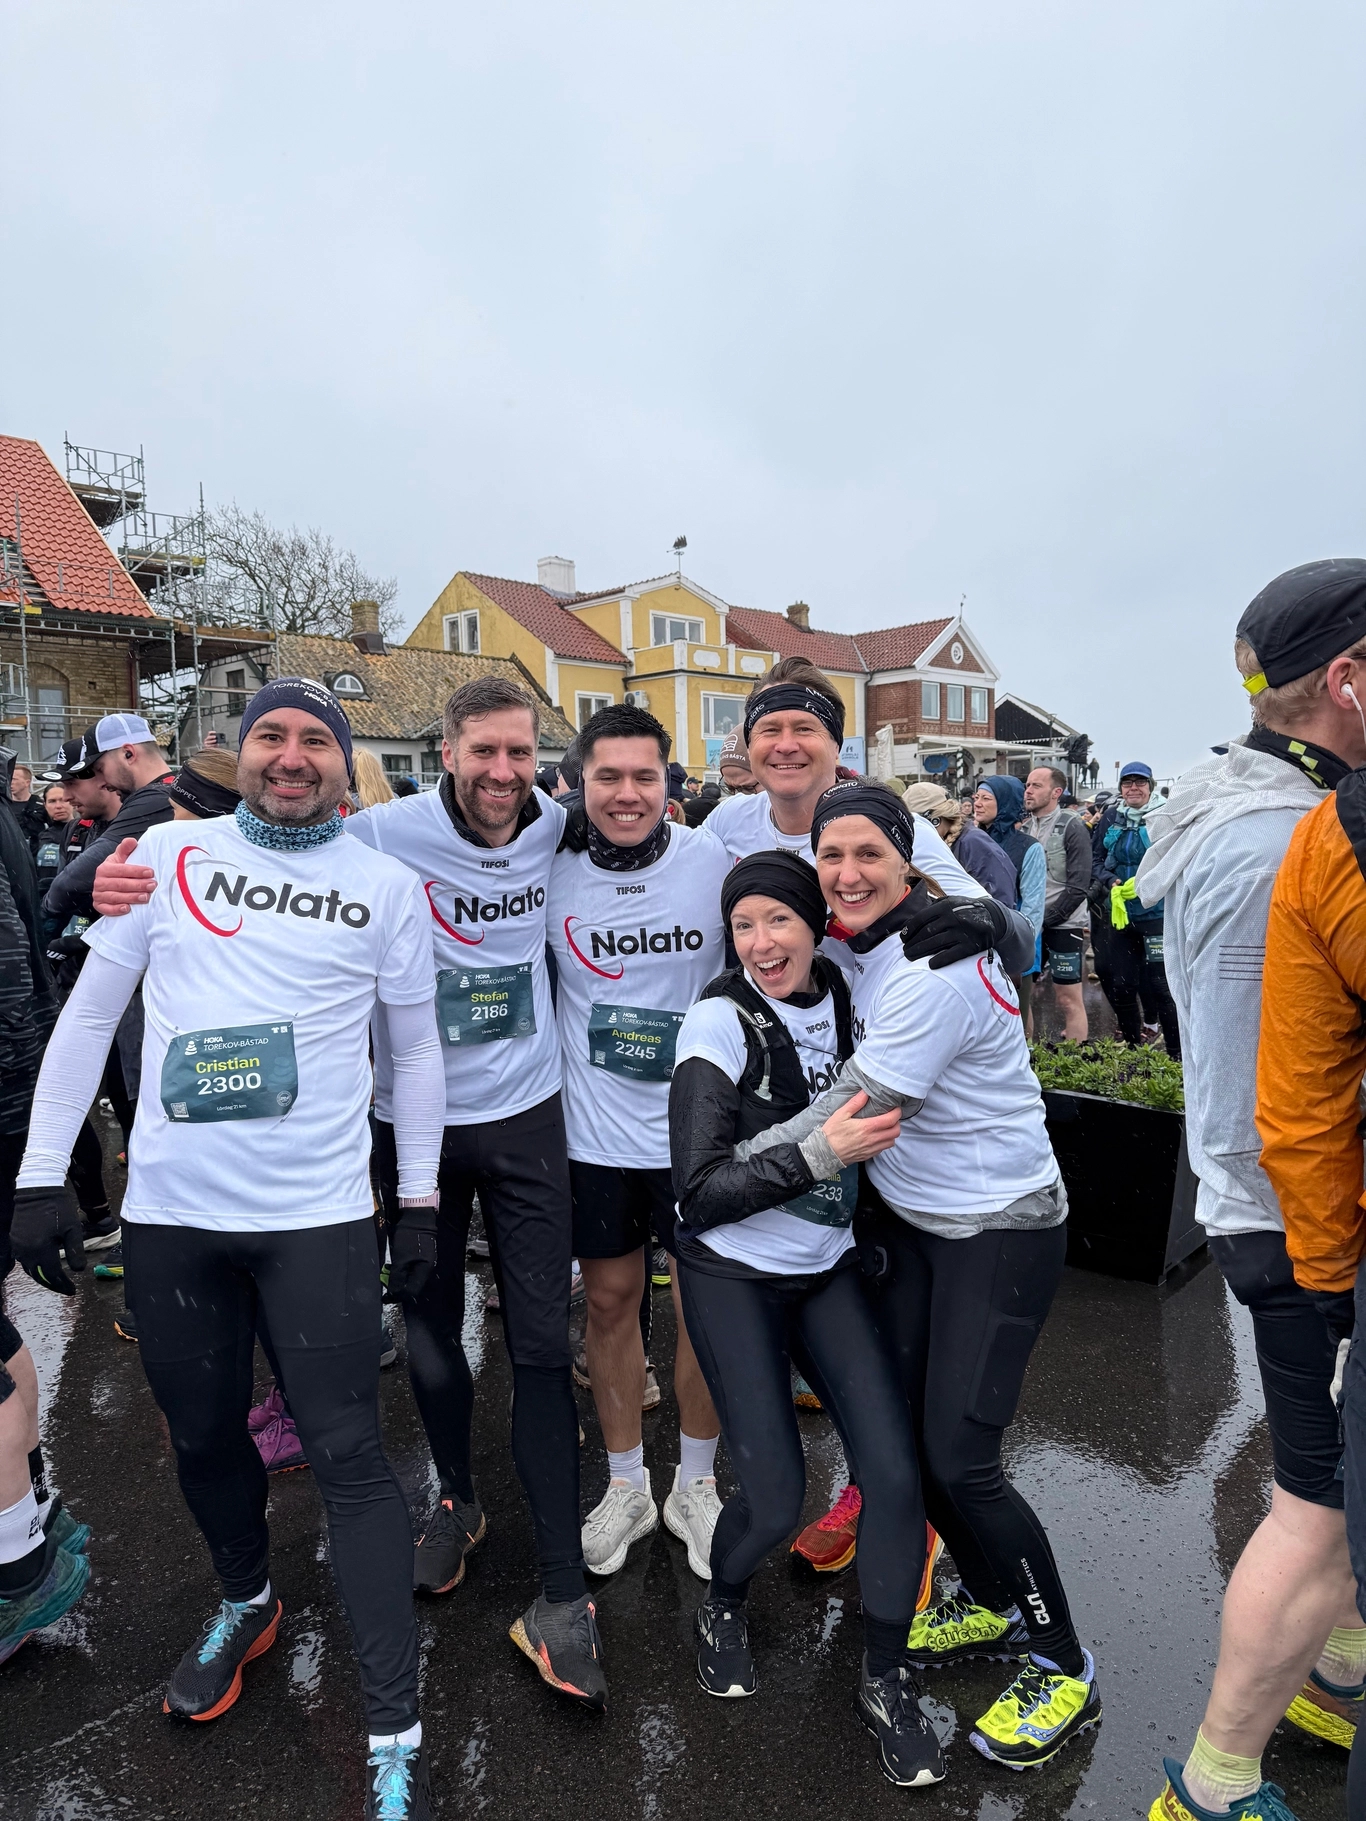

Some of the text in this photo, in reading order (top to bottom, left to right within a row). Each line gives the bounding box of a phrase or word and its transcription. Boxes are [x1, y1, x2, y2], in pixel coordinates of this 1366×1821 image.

[303, 690, 328, 707] HOKA
[481, 859, 510, 869] TIFOSI
[616, 884, 646, 895] TIFOSI
[204, 871, 371, 929] Nolato
[454, 885, 545, 924] Nolato
[590, 925, 704, 959] Nolato
[471, 991, 509, 1003] Stefan
[471, 1003, 508, 1021] 2186
[621, 1017, 669, 1028] TOREKOV-BÅSTAD
[203, 1036, 224, 1044] HOKA
[203, 1037, 269, 1052] TOREKOV-BÅSTAD
[611, 1029, 662, 1044] Andreas
[615, 1041, 656, 1060] 2245
[195, 1056, 260, 1074] Cristian
[196, 1072, 262, 1096] 2300
[809, 1184, 843, 1202] 233
[1020, 1557, 1038, 1591] ATHLETICS
[926, 1624, 1003, 1653] saucony
